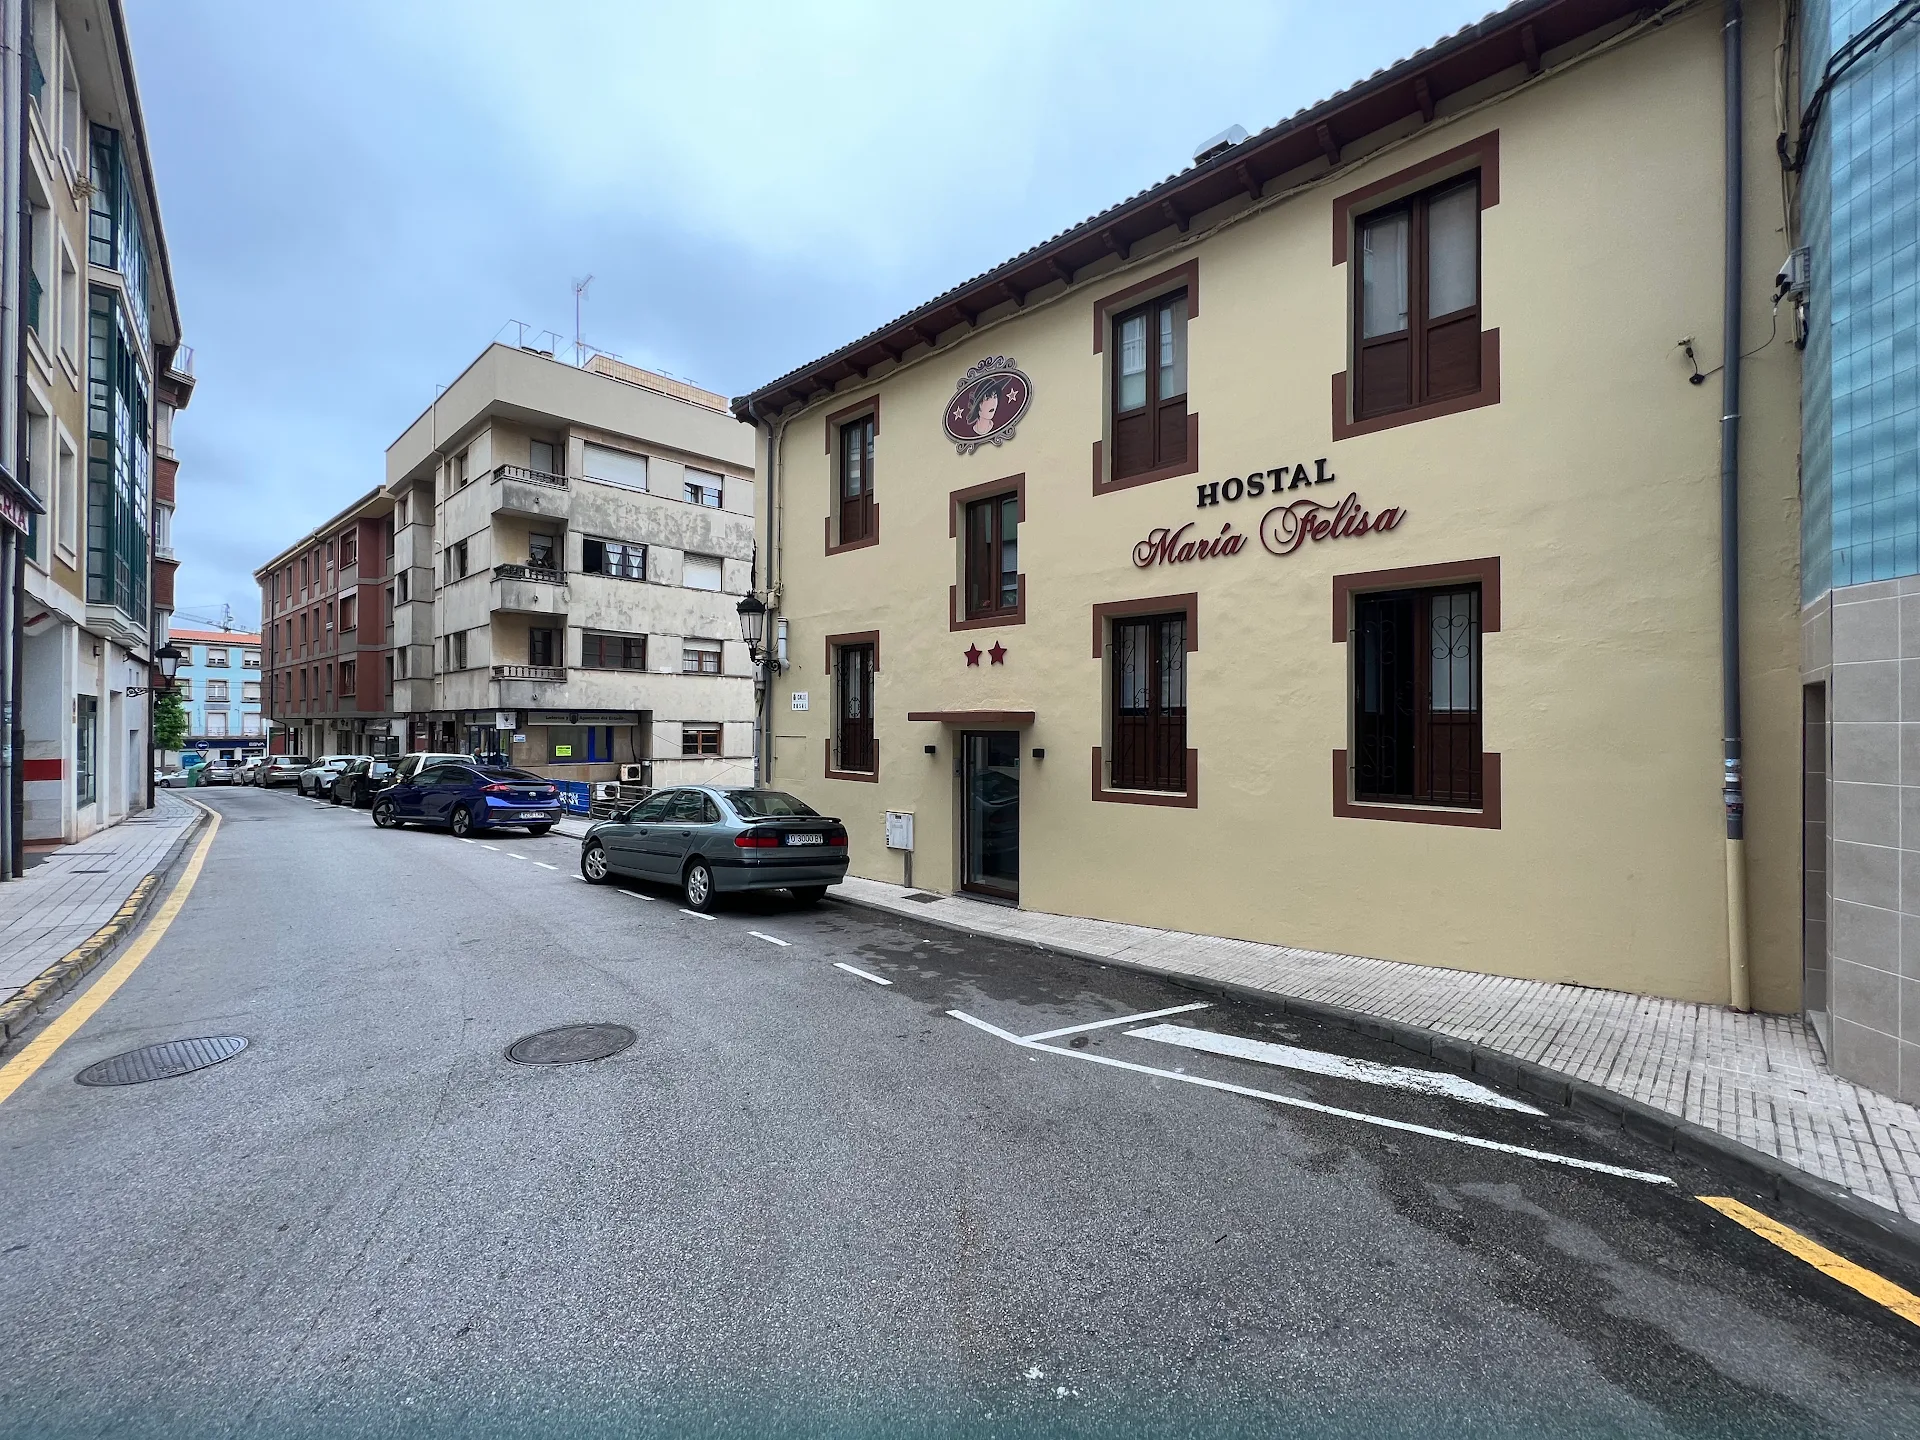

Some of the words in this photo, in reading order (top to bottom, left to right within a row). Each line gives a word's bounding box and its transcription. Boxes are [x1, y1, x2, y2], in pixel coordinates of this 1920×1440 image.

[1197, 458, 1335, 508] HOSTAL
[0, 495, 27, 532] RIA
[1132, 522, 1247, 568] María
[1260, 491, 1406, 555] Felisa
[797, 834, 813, 842] 3000
